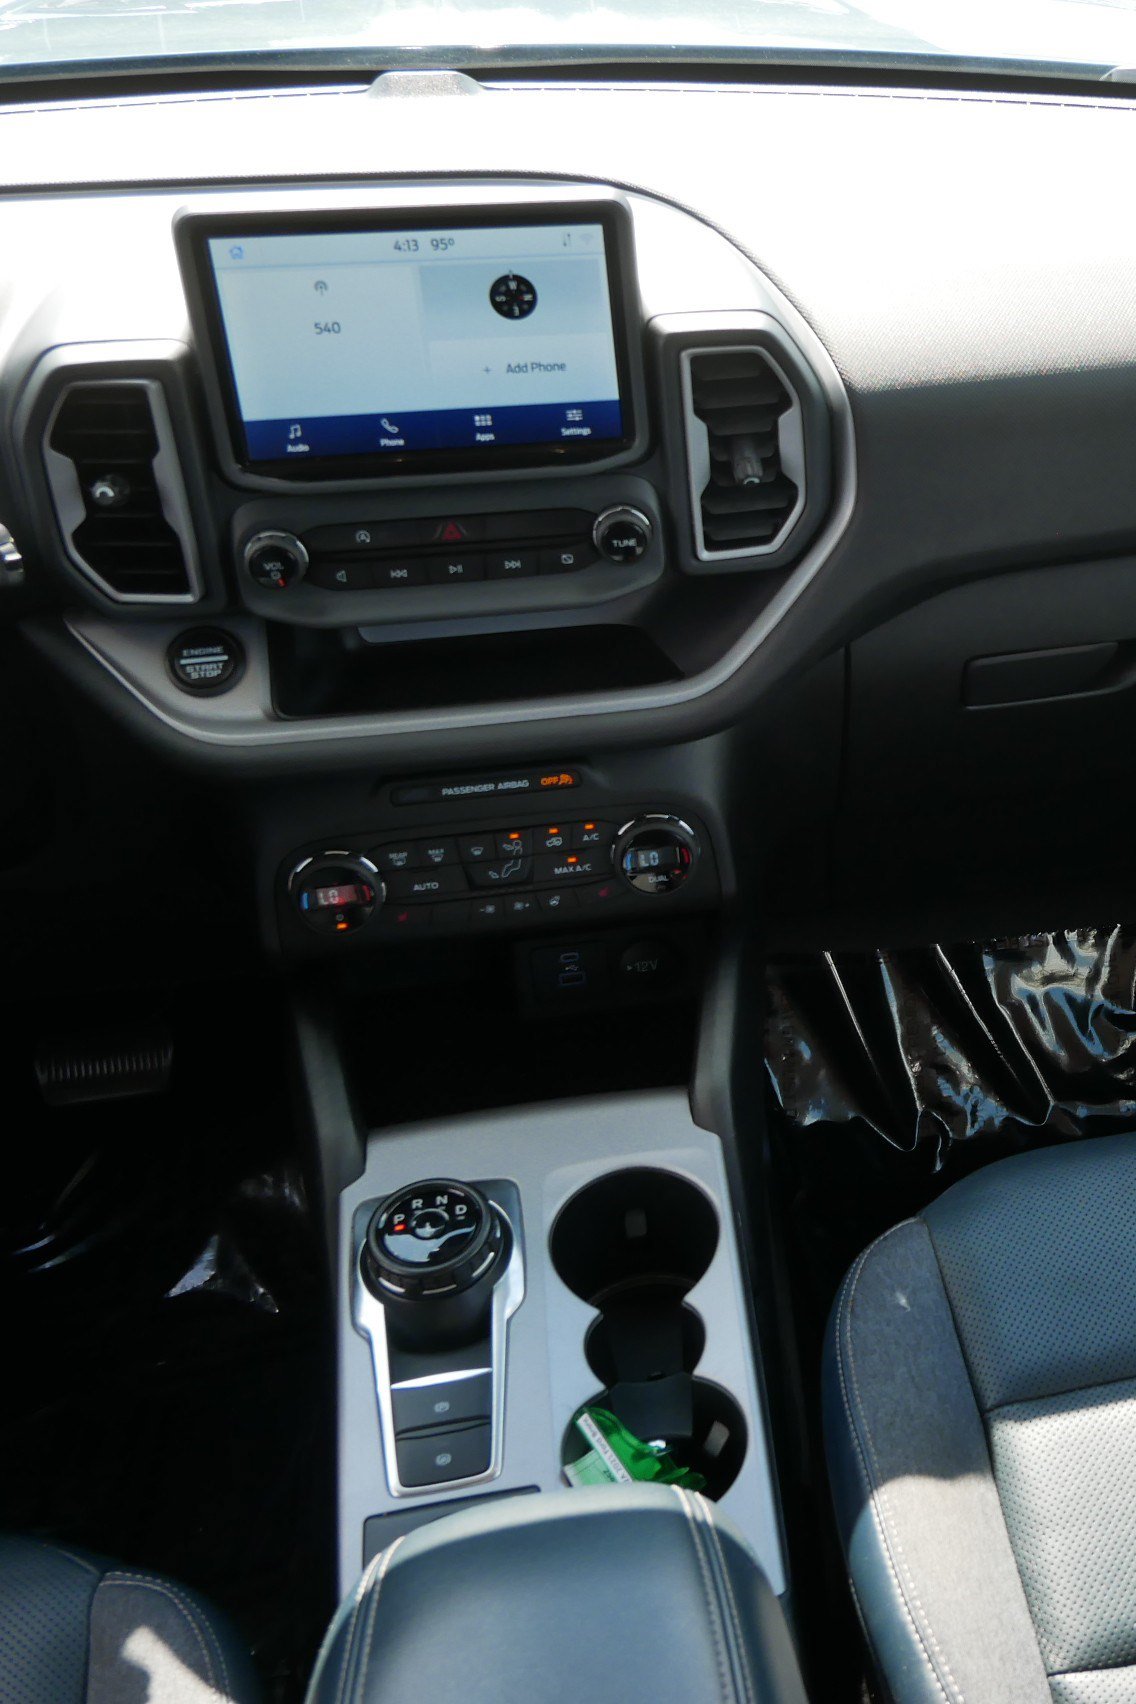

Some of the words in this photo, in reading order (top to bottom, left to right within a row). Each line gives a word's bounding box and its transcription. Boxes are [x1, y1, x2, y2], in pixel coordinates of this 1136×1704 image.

[393, 239, 419, 252] 4:13
[314, 321, 341, 335] 540
[506, 363, 528, 374] Add
[531, 361, 567, 373] Phone
[561, 427, 592, 437] Settings
[380, 438, 405, 447] Phone
[475, 433, 496, 442] Apps
[286, 443, 310, 453] Audio
[612, 538, 637, 548] TUNE
[263, 561, 285, 570] VOL
[182, 645, 224, 657] ENGINE
[186, 662, 225, 674] START
[190, 669, 222, 679] STOP
[442, 783, 495, 796] PASSENGER
[497, 779, 530, 790] AIRBAG
[582, 832, 600, 842] A/C
[554, 865, 574, 875] MAX
[575, 863, 592, 872] A/C
[648, 874, 669, 883] DUAL
[413, 881, 439, 891] AUTO
[393, 1213, 405, 1224] P
[412, 1198, 424, 1210] R
[435, 1194, 449, 1206] N
[455, 1204, 468, 1215] D
